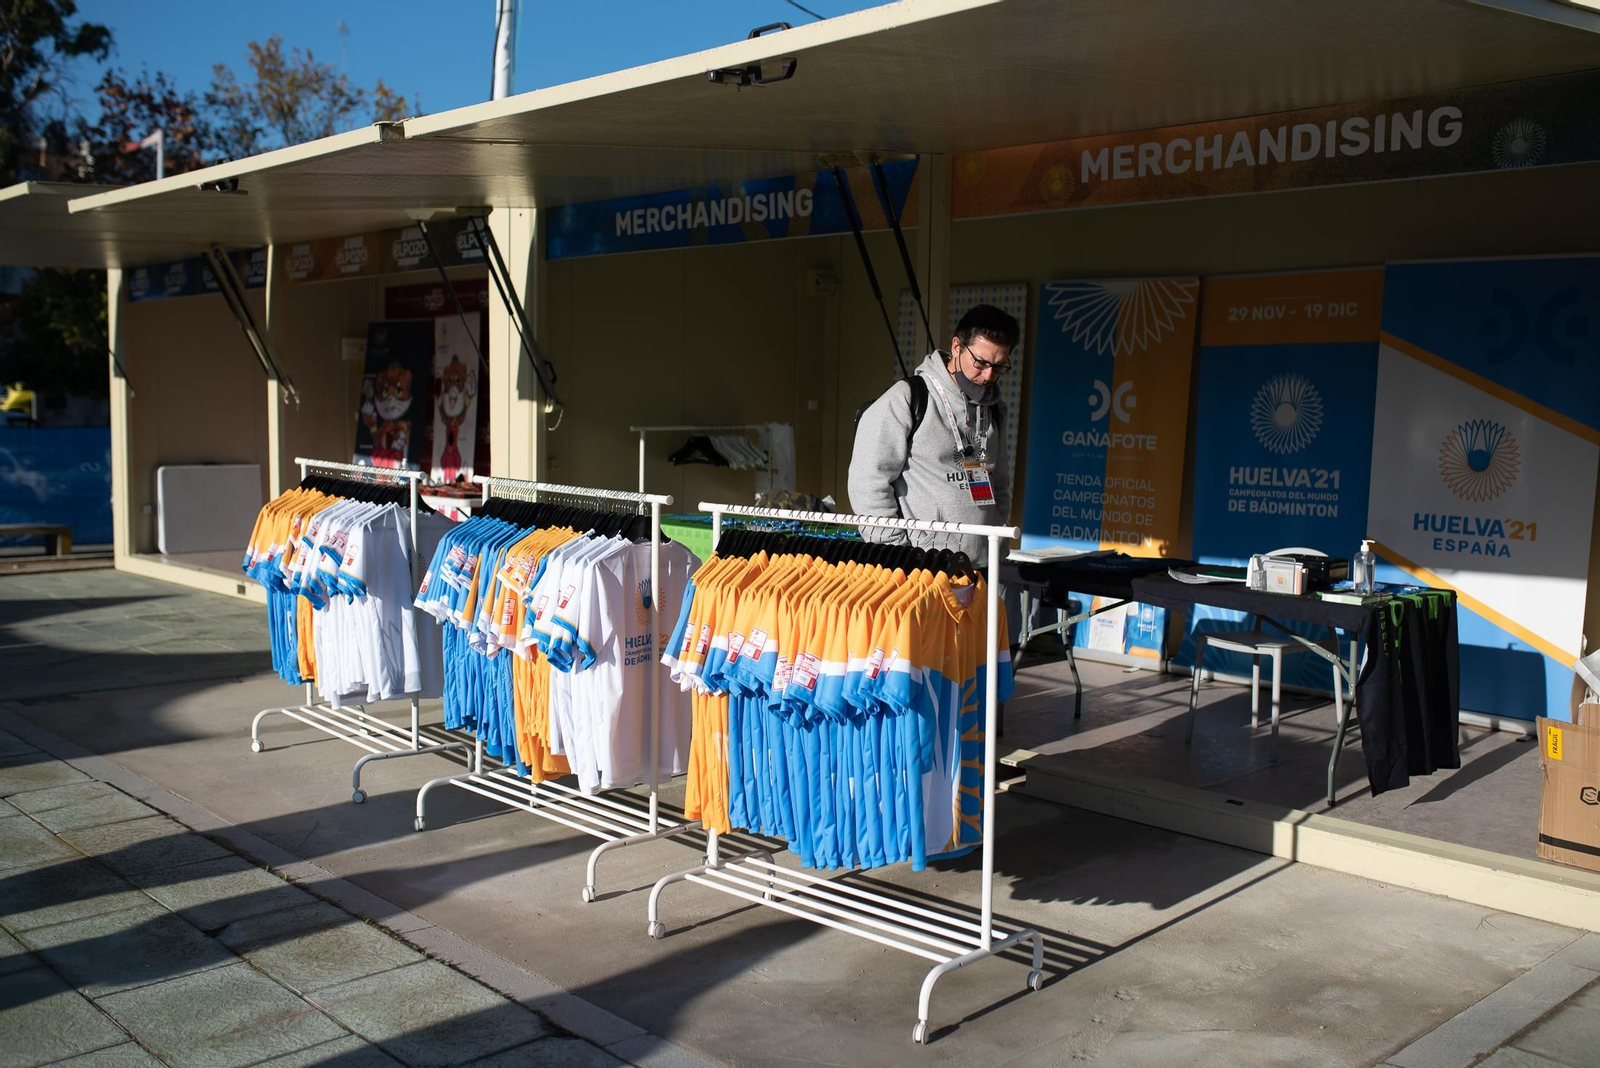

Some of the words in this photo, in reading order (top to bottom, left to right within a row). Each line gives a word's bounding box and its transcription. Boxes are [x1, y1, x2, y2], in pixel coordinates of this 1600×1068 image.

[1080, 105, 1464, 184] MERCHANDISING
[615, 188, 814, 237] MERCHANDISING
[1228, 306, 1249, 322] 29
[1252, 304, 1287, 321] NOV
[1304, 303, 1324, 319] 19
[1327, 301, 1358, 318] DIC
[1055, 472, 1102, 487] TIENDA
[1105, 476, 1156, 492] OFICIAL
[1053, 488, 1156, 509] CAMPEONATOS
[1227, 498, 1246, 513] DE
[1228, 488, 1288, 500] CAMPEONATOS
[1288, 490, 1306, 500] DEL
[1307, 491, 1339, 502] MUNDO
[1052, 505, 1078, 519] DEL
[1080, 507, 1132, 524] MUNDO
[1135, 513, 1153, 527] DE
[1049, 523, 1153, 548] BADMINTON
[1433, 537, 1511, 558] ESPAÑA
